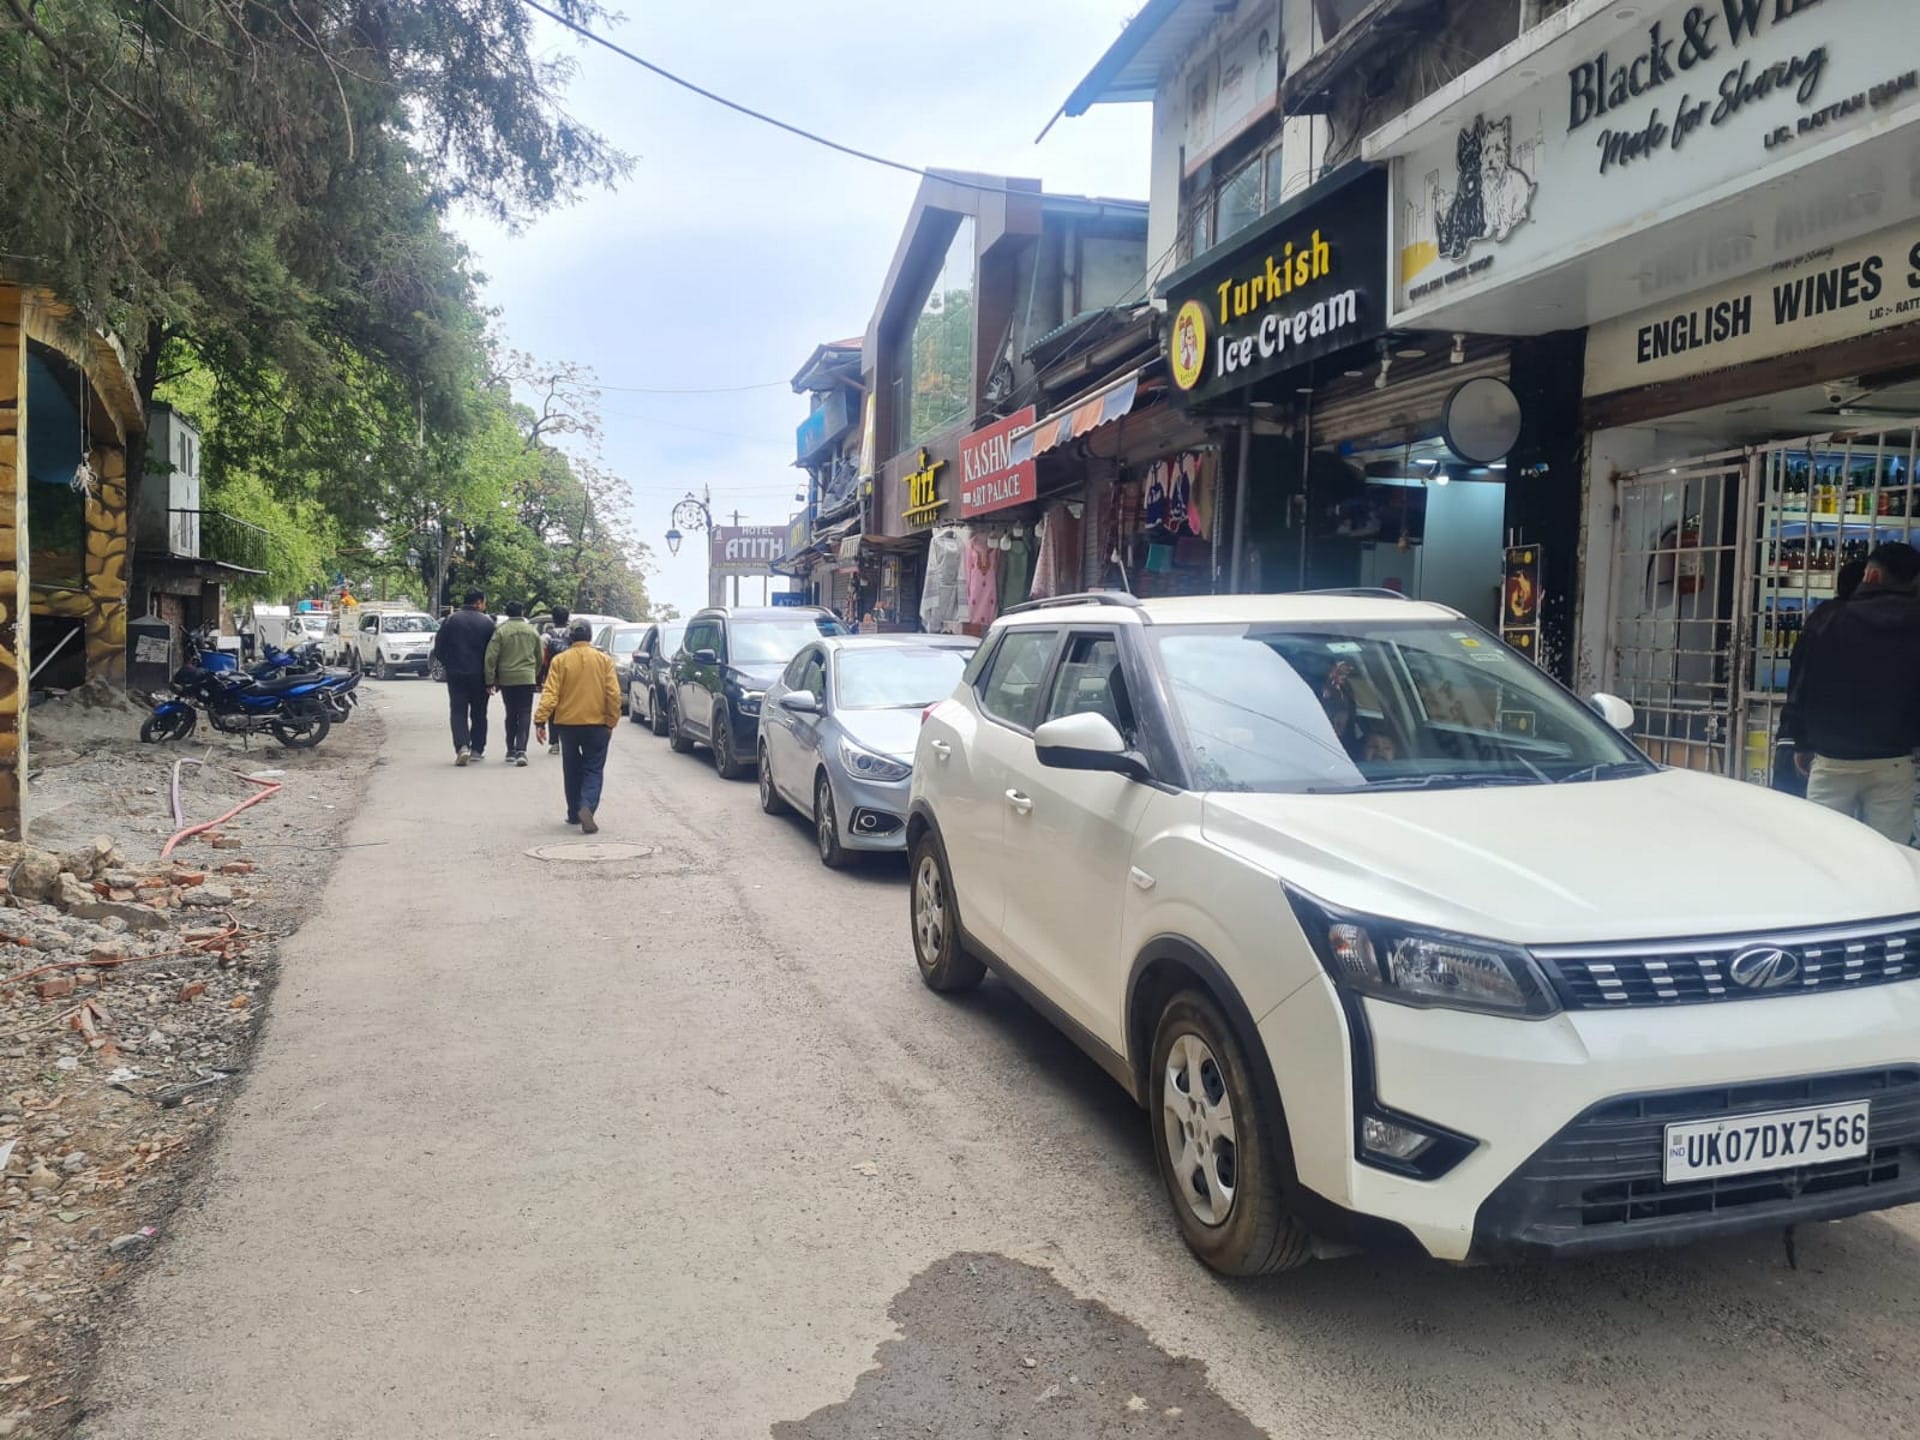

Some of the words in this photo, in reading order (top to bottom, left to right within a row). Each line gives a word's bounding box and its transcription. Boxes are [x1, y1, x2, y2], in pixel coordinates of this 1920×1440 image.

[1597, 108, 1669, 174] Made
[1672, 94, 1711, 149] for
[1711, 46, 1828, 126] Sharing
[1217, 229, 1331, 325] Turkish
[1637, 295, 1752, 364] ENGLISH
[1773, 256, 1884, 325] WINES
[1217, 333, 1251, 377] Ice
[1258, 289, 1357, 359] Cream
[903, 459, 945, 508] RITZ
[971, 484, 986, 508] ART
[987, 473, 1021, 504] PALACE
[742, 526, 774, 536] HOTEL
[1687, 1113, 1867, 1168] UK07DX7566
